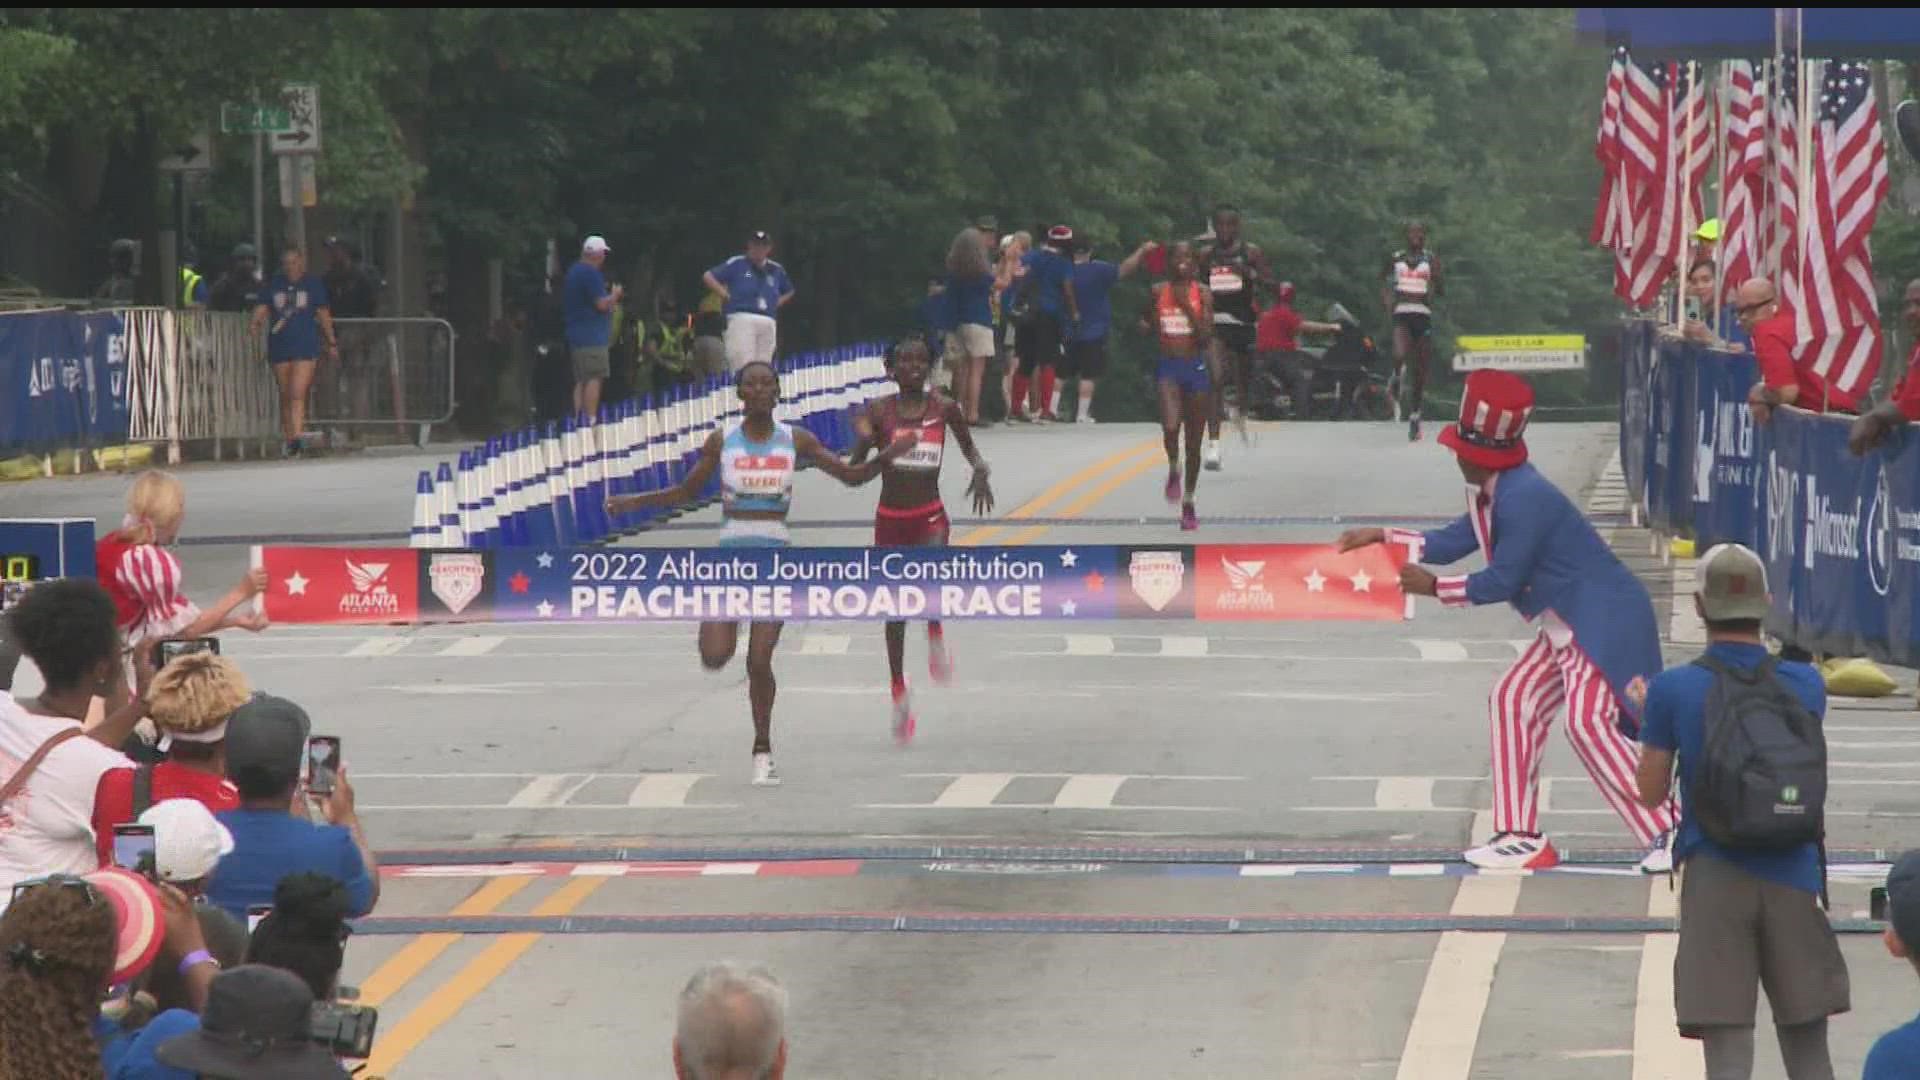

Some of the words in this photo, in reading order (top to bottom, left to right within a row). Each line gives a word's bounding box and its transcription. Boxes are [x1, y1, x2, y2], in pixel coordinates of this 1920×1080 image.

[571, 554, 647, 580] 2022
[657, 550, 757, 580] Atlanta
[767, 550, 1044, 580] Journal-Constitution
[339, 593, 398, 608] ATLANTA
[571, 585, 793, 617] PEACHTREE
[808, 585, 926, 617] ROAD
[941, 585, 1042, 617] RACE
